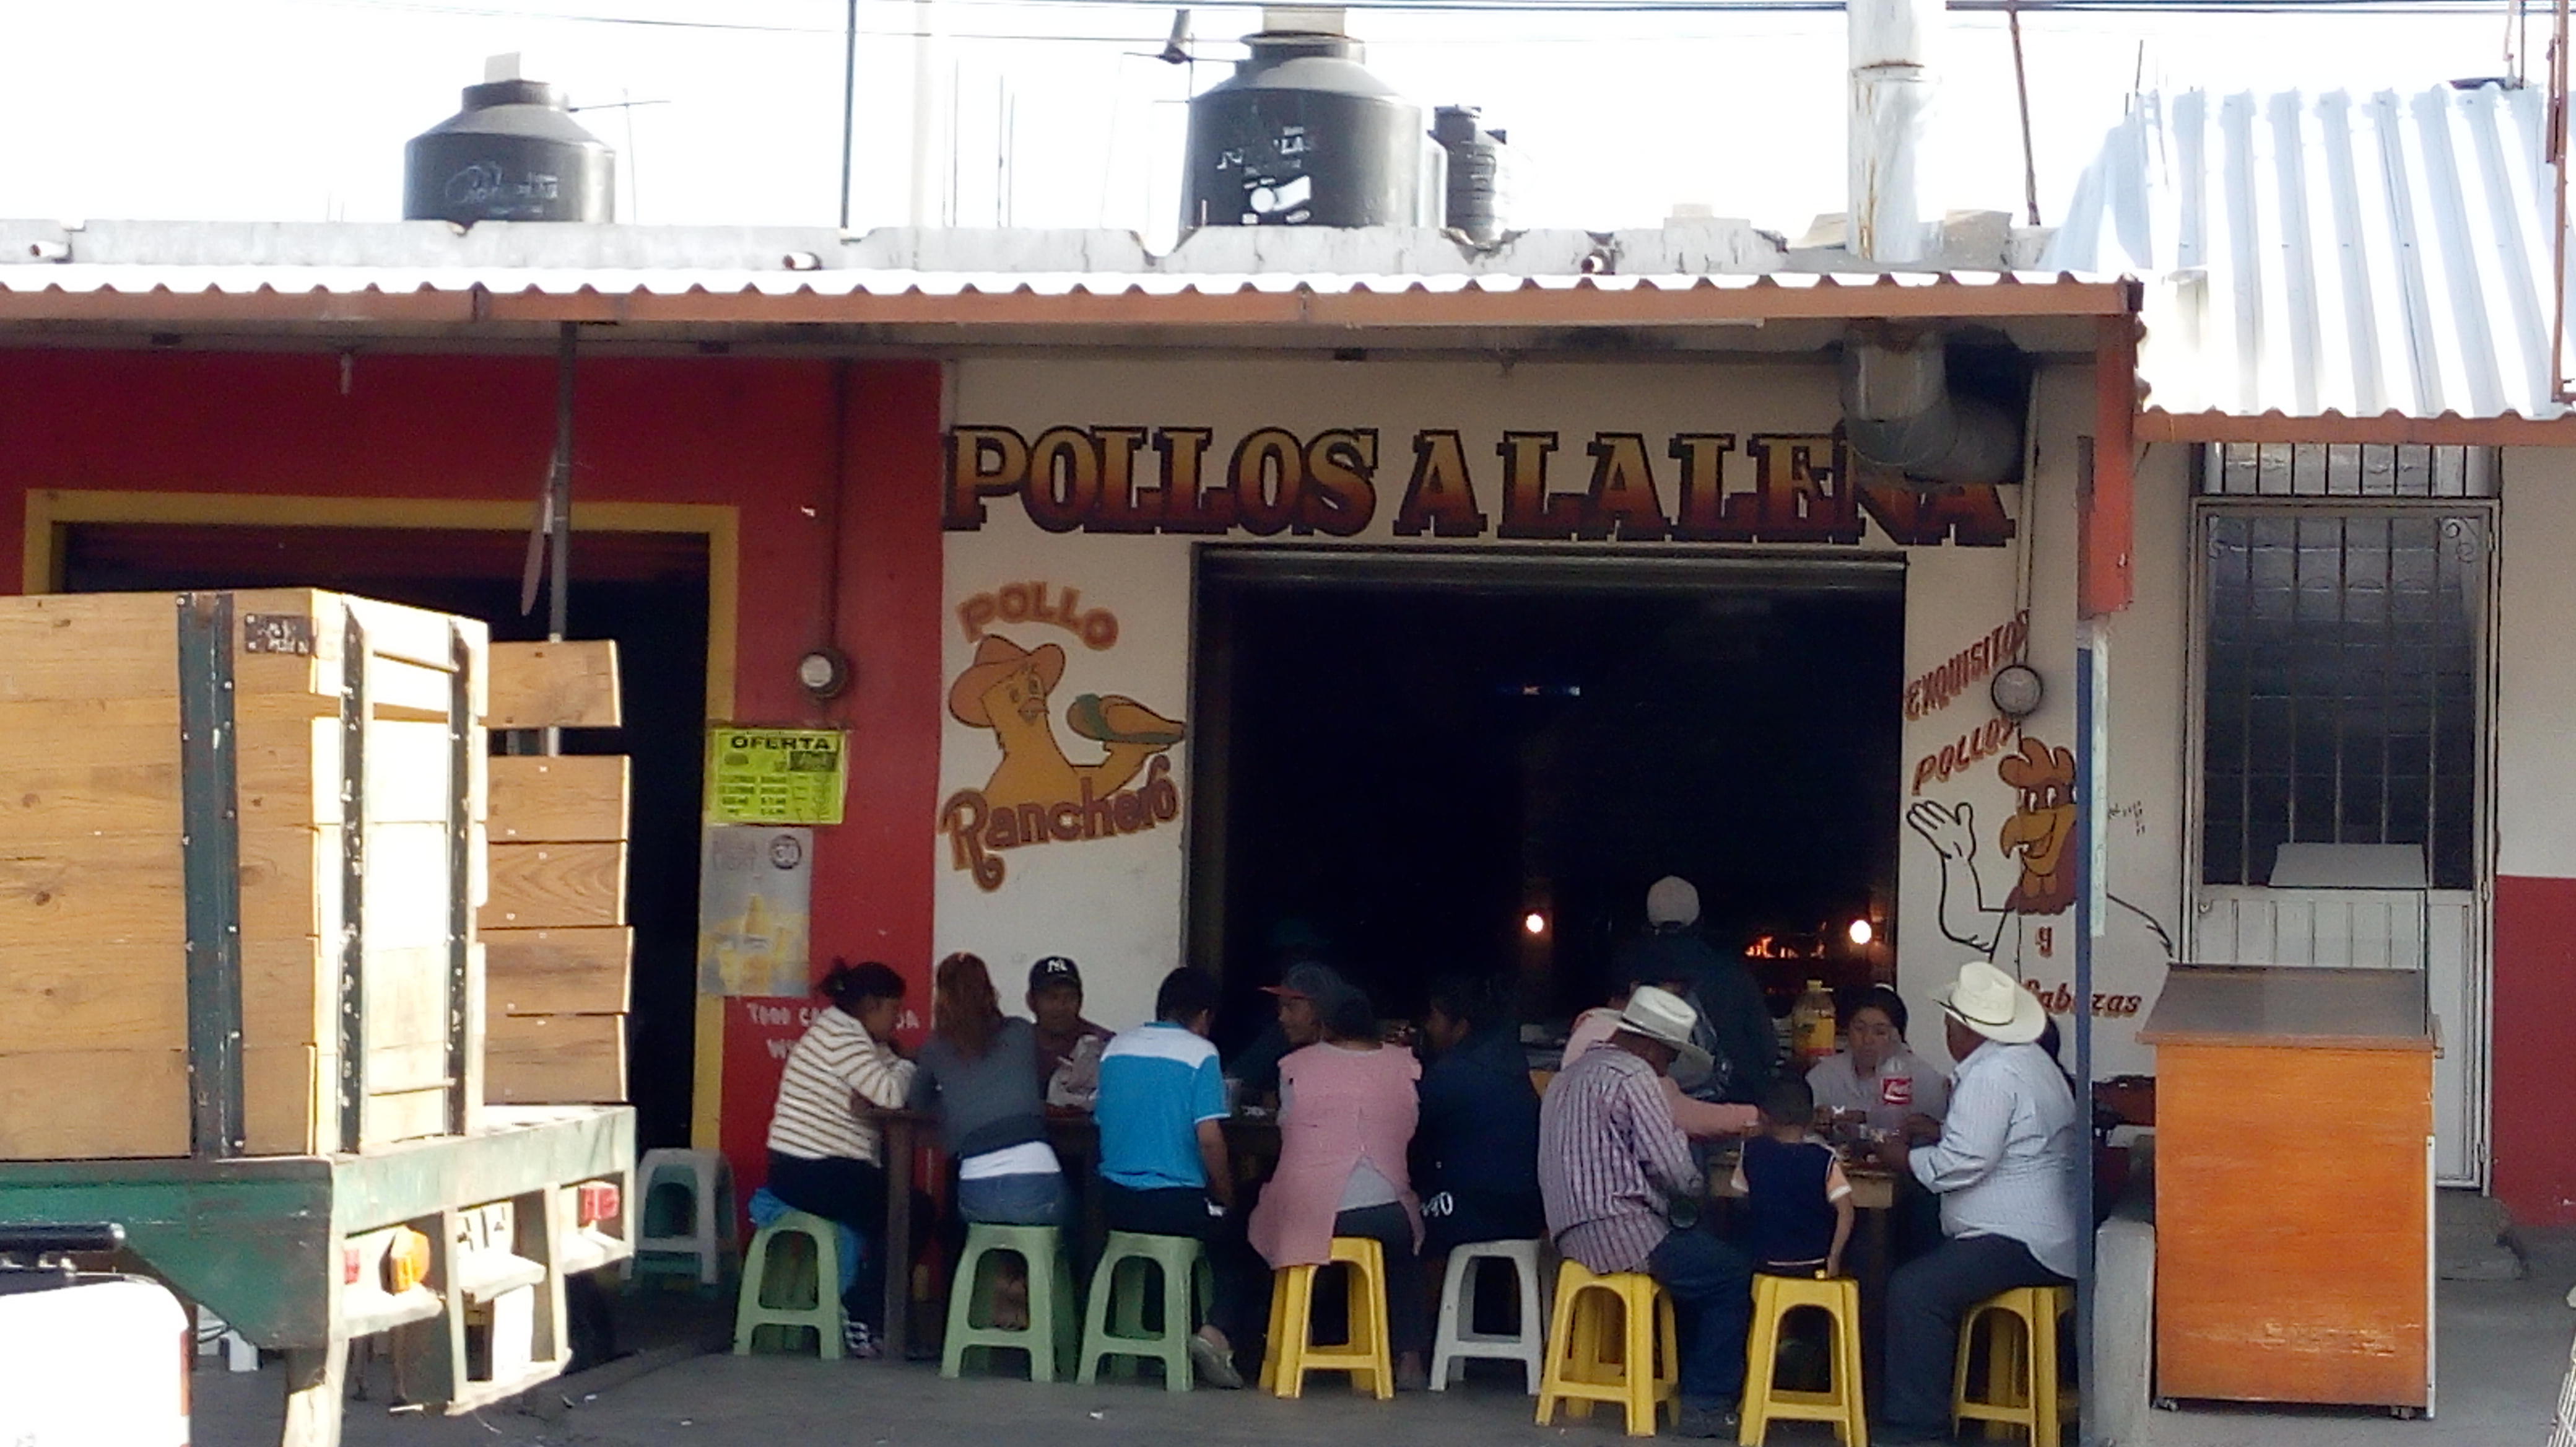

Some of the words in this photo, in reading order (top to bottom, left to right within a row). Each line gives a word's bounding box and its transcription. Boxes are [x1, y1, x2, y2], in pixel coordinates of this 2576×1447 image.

[942, 424, 1380, 538] POLLOS
[1393, 429, 1488, 538] A
[1495, 430, 1671, 541] LA
[955, 580, 1118, 650] POLLO
[730, 735, 830, 750] OFERTA
[938, 754, 1180, 893] Ranchero
[2023, 979, 2143, 1018] abzas
